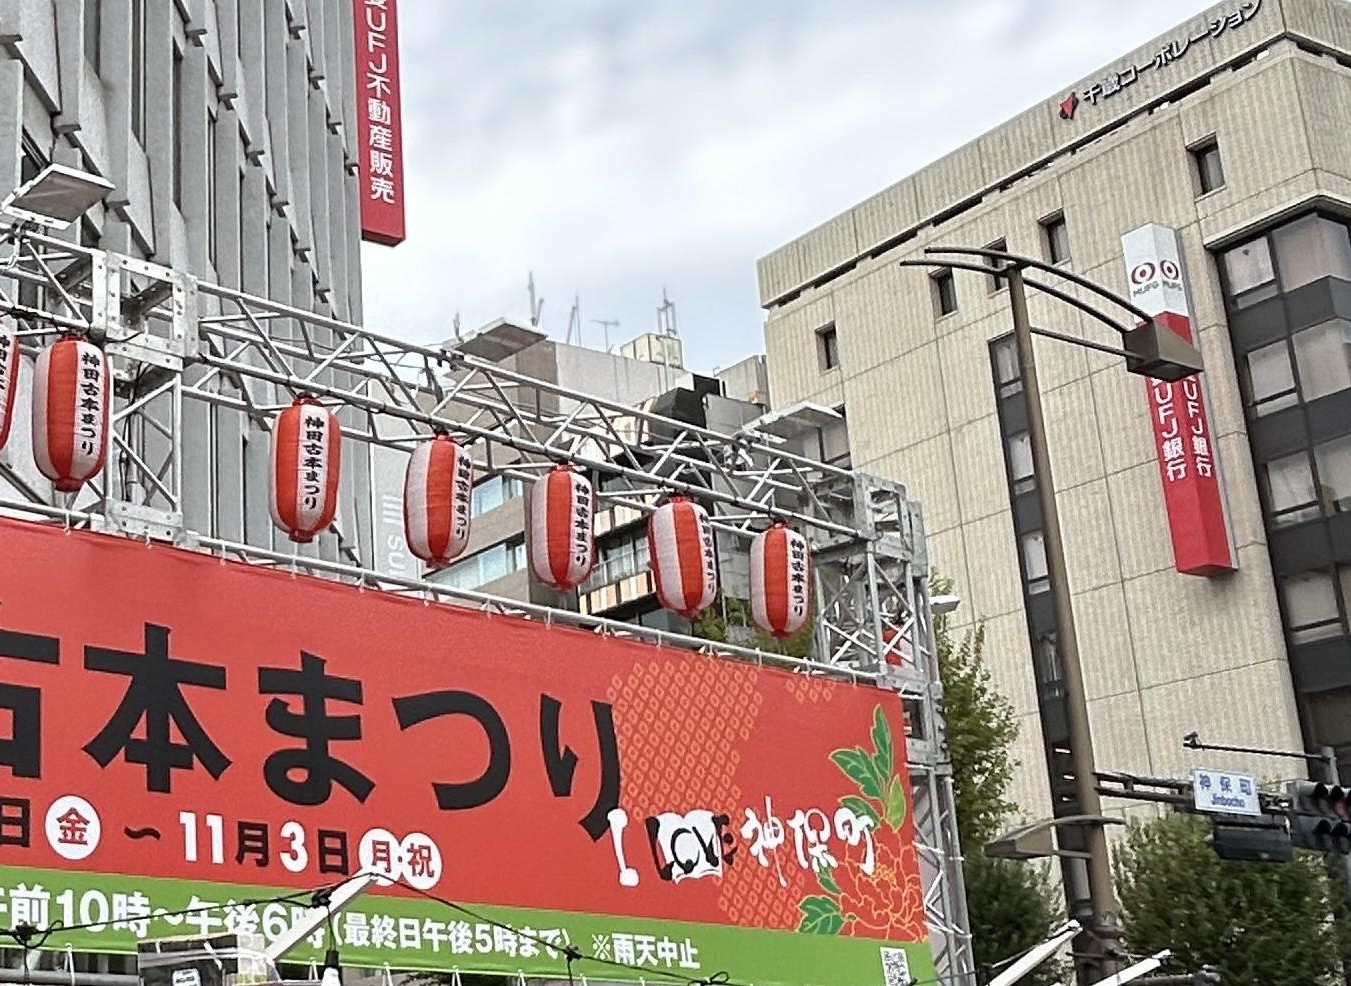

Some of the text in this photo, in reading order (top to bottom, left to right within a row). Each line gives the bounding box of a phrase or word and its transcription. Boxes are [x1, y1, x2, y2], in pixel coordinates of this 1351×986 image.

[78, 351, 102, 457] 神田古本まつり
[302, 415, 325, 510] 神田古本まつり
[590, 932, 702, 970] ※雨天中止
